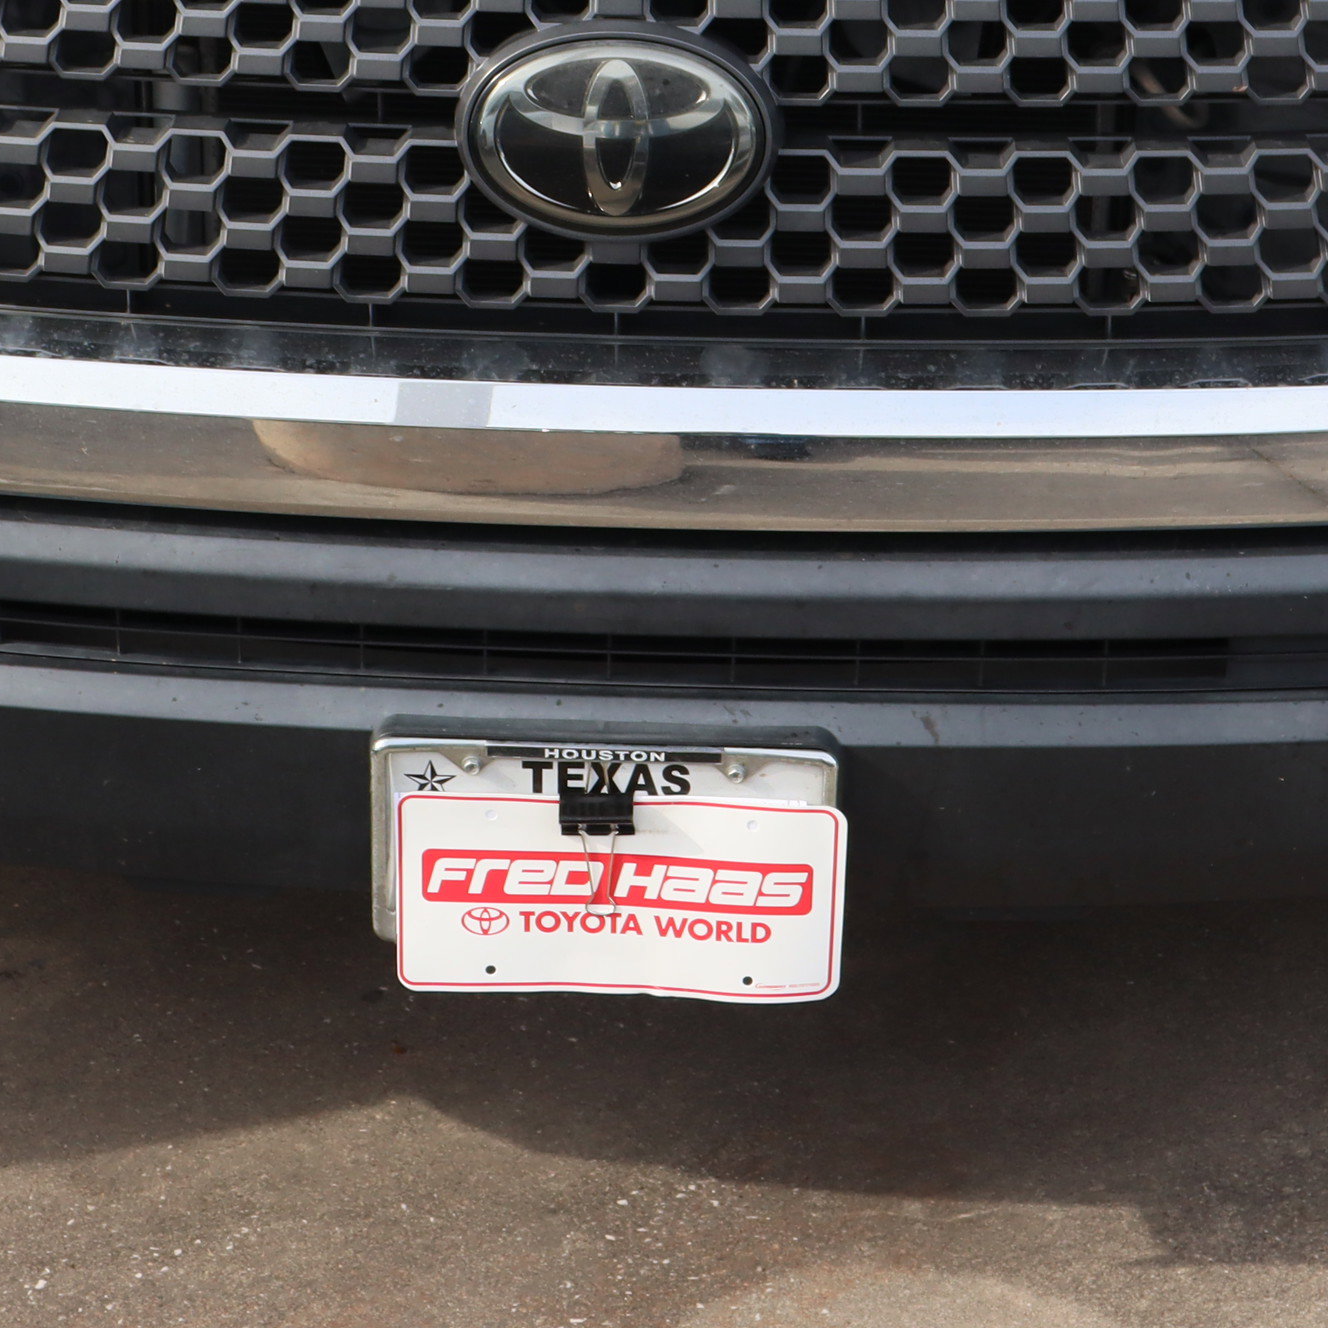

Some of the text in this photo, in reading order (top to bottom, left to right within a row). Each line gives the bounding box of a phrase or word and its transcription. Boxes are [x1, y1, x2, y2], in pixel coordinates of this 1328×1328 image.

[543, 748, 667, 762] HOUSTON
[522, 761, 691, 797] TEXAS
[519, 910, 772, 944] TOYOTA WORLD
